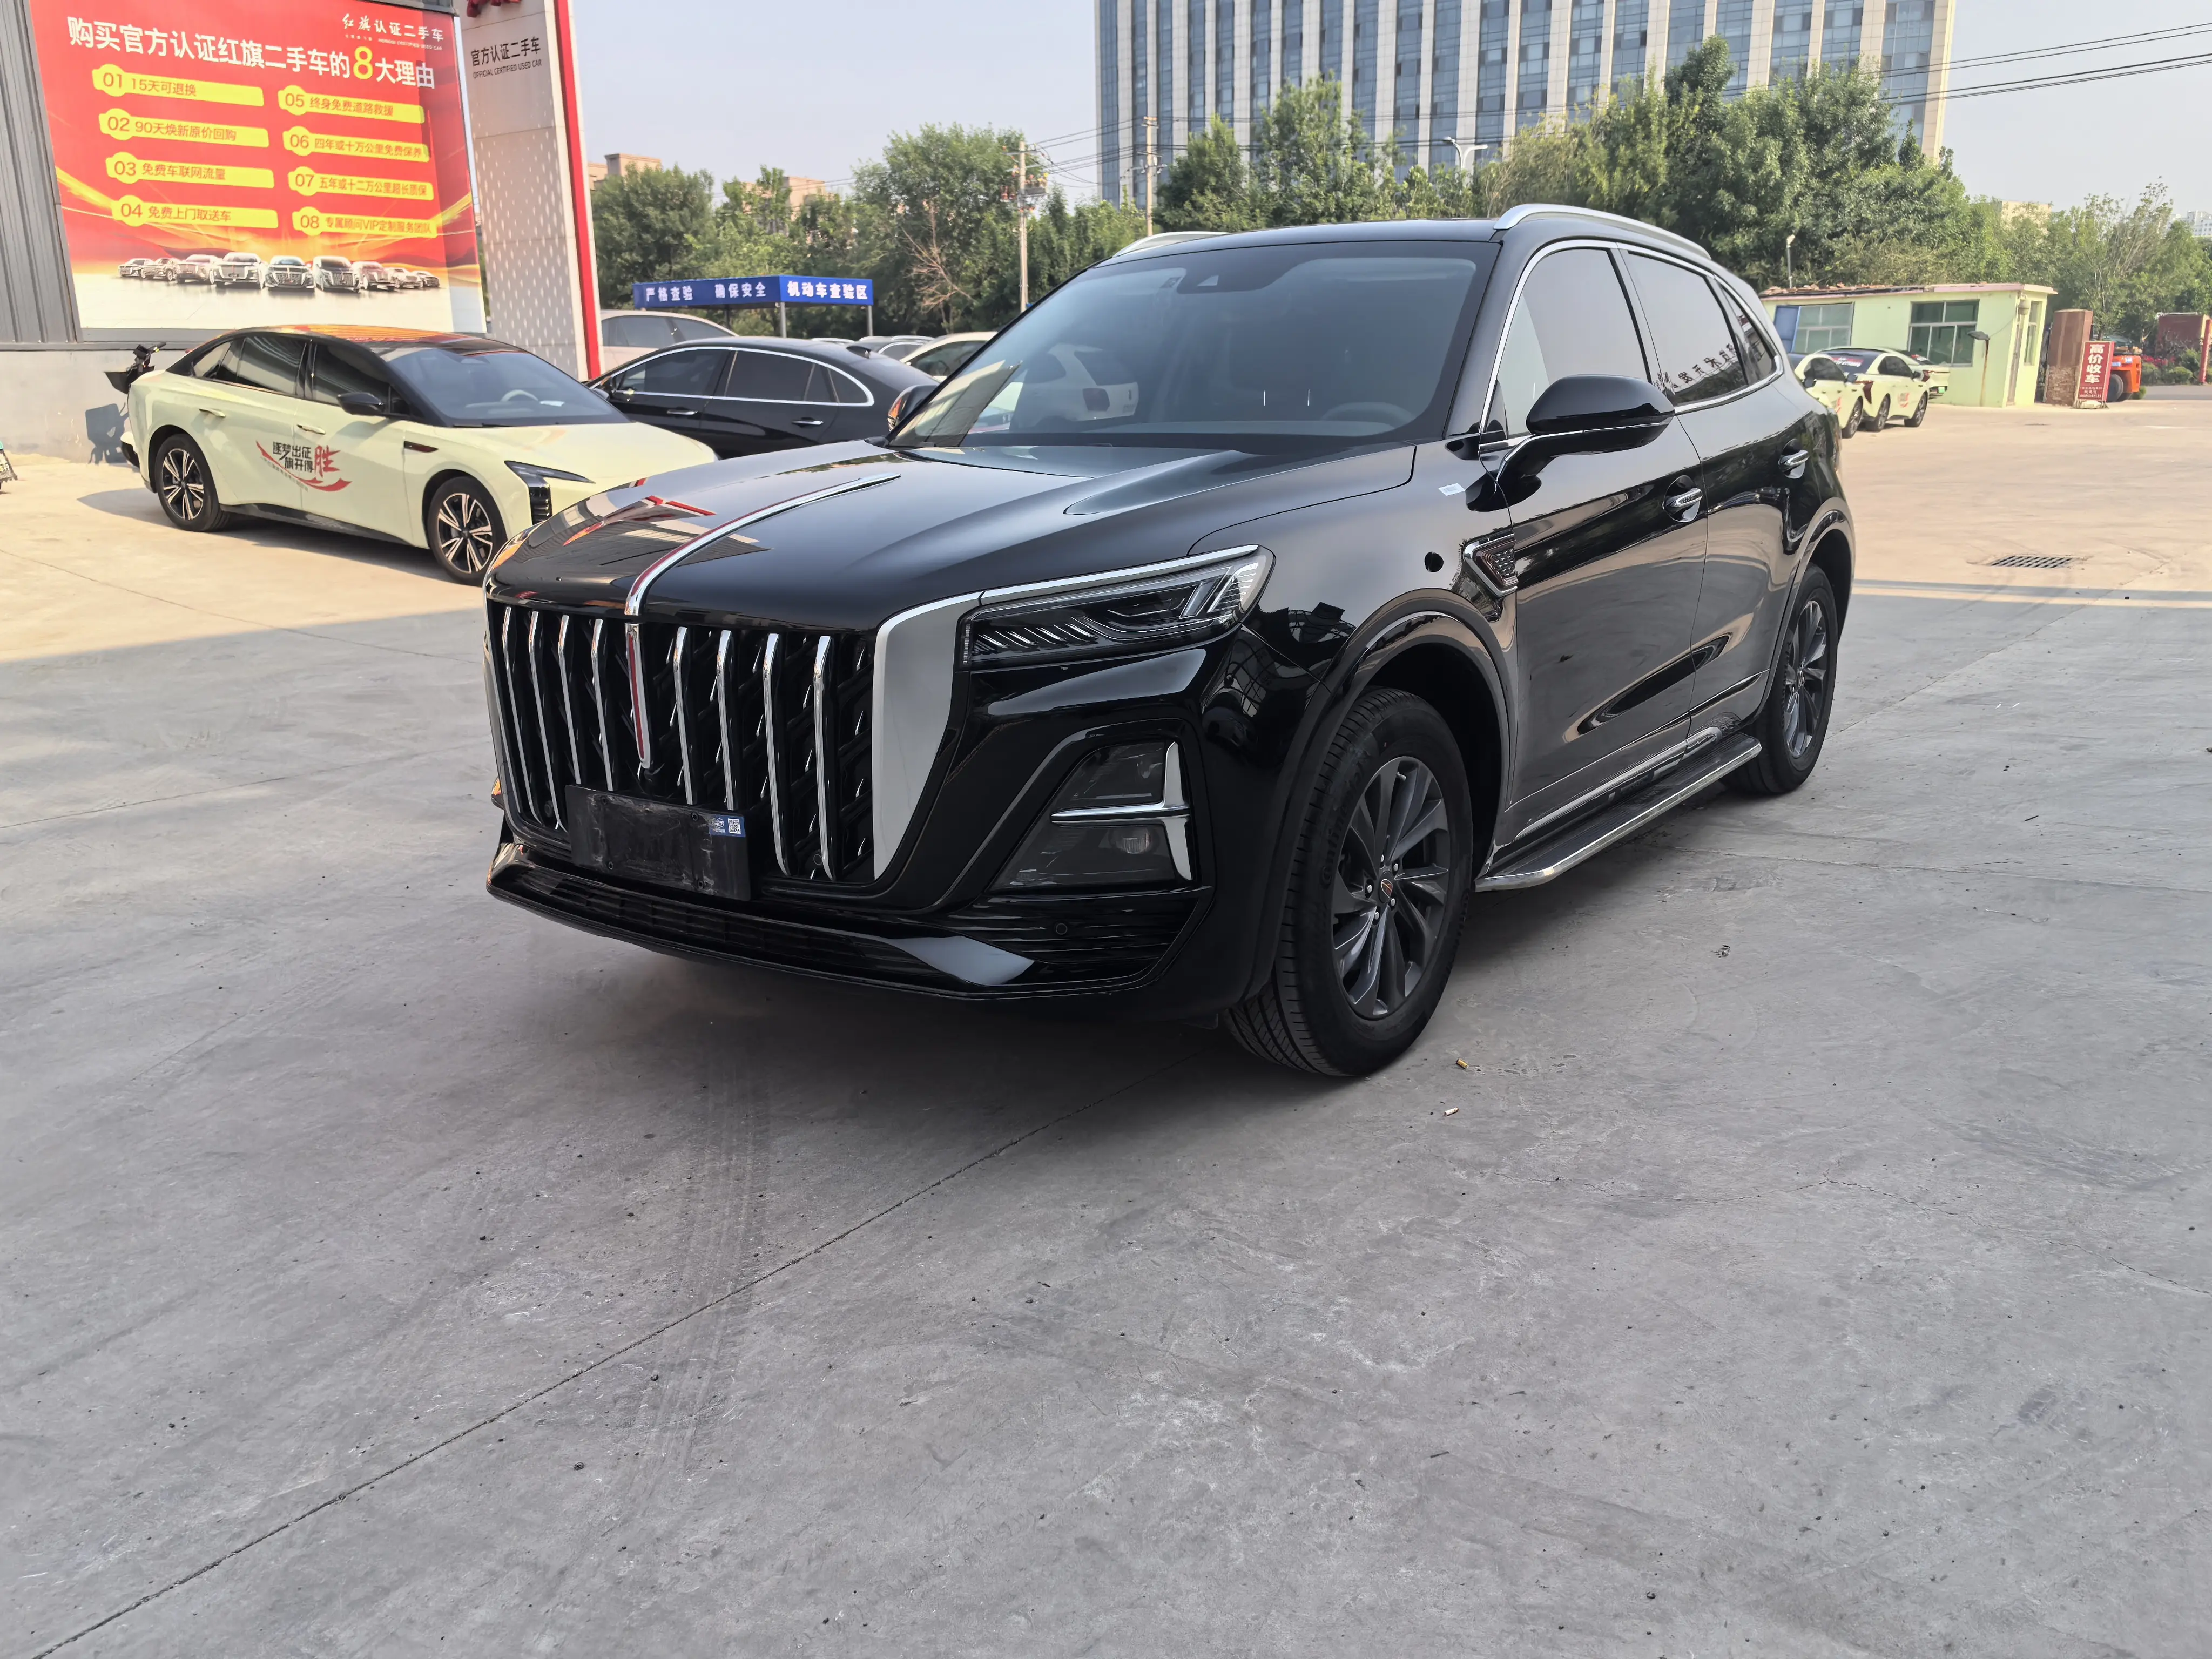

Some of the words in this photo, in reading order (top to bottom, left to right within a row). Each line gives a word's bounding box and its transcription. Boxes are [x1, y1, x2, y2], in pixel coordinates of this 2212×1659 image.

[342, 13, 443, 42] 红旗认证二手车
[67, 16, 435, 89] 购买官方认证红旗二手车的8大理由
[470, 36, 541, 67] 官方认证二手车
[473, 69, 493, 79] OFFICIAL
[494, 64, 517, 75] CERTIFIED
[518, 62, 530, 70] USED
[532, 59, 542, 68] CAR
[103, 72, 122, 89] 01
[131, 78, 197, 97] 15天可退换
[285, 93, 305, 108] 05
[309, 97, 394, 117] 终身免费道路救援
[107, 116, 130, 132] 02
[135, 122, 237, 141] 90天焕新原价回购
[290, 134, 309, 149] 06
[314, 138, 422, 158] 四年或十万公里免费保养
[114, 161, 136, 176] 03
[141, 163, 226, 180] 免费车联网流量
[295, 174, 314, 188] 07
[319, 177, 427, 196] 五年或十二万公里超长质保
[120, 203, 143, 218] 04
[148, 206, 231, 222] 免费上门取送车
[300, 215, 319, 229] 08
[325, 217, 432, 234] 专属顾问VIP定制服务团队
[646, 286, 694, 302] 严格查验
[714, 282, 766, 299] 确保安全
[787, 280, 868, 300] 机动车查验区
[2085, 344, 2105, 384] 高价收车
[273, 441, 312, 461] 逐梦出征
